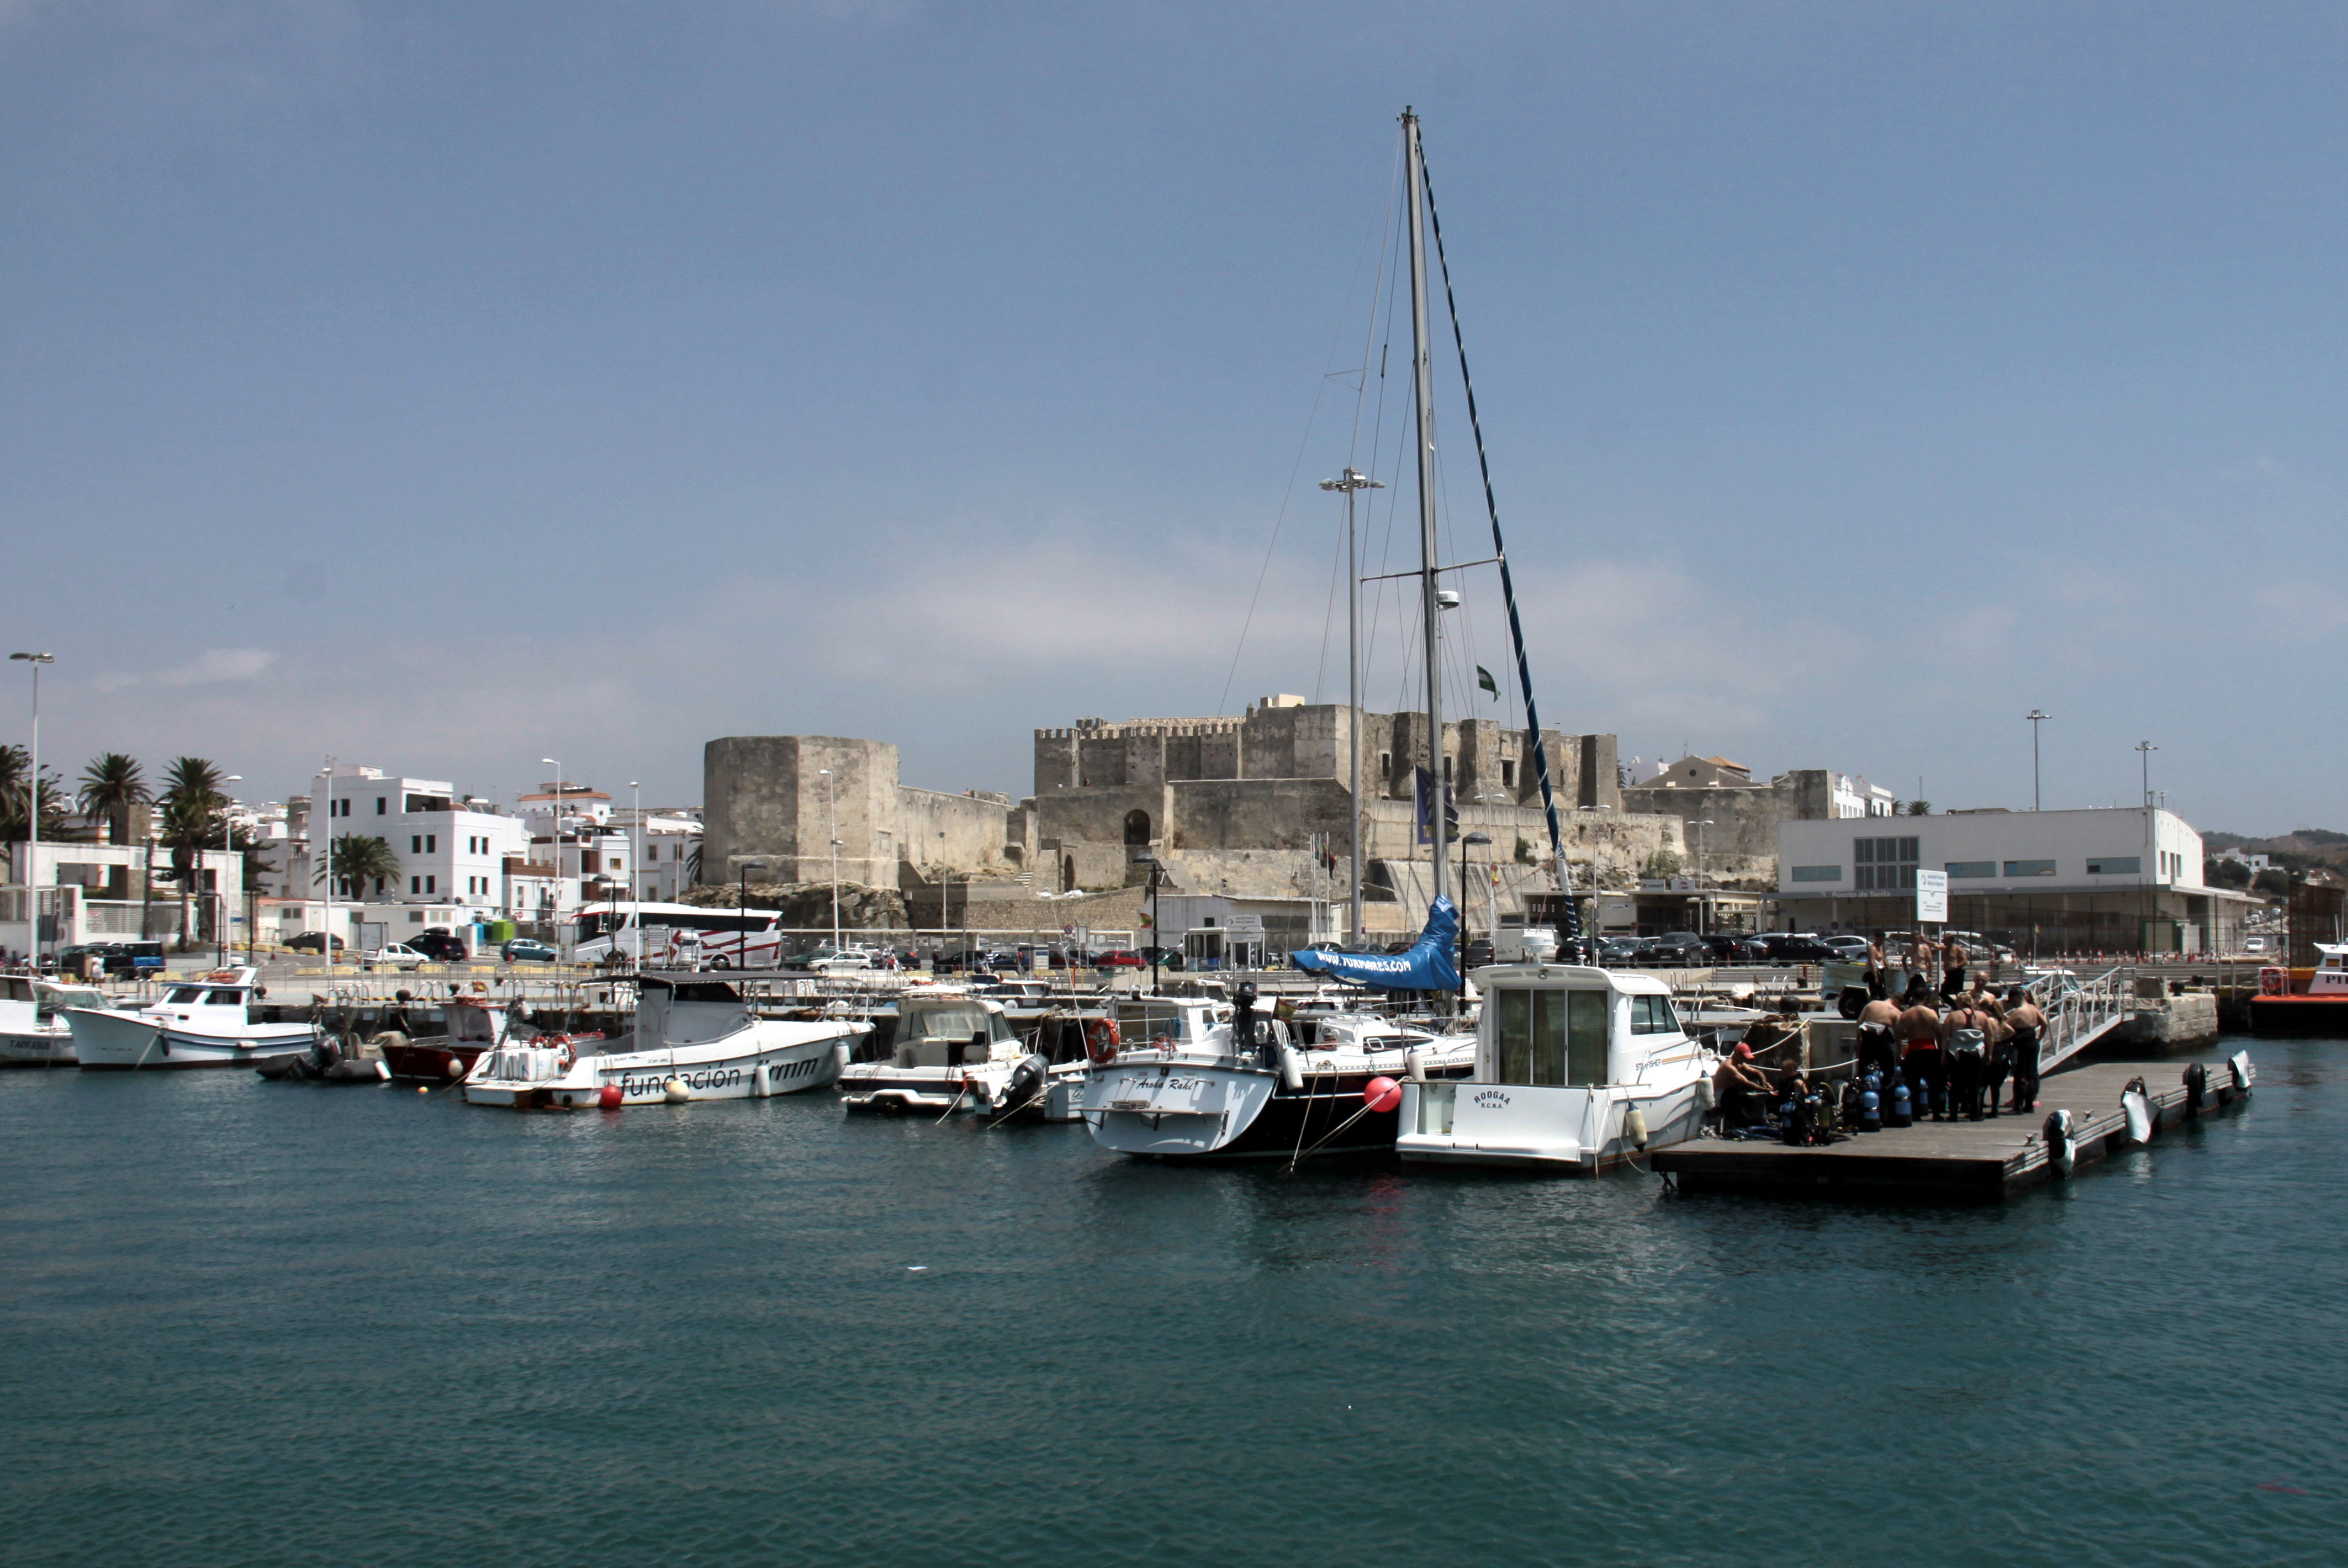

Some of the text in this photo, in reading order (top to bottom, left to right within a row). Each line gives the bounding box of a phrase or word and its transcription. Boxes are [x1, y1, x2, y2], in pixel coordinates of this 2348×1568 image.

[9, 1040, 51, 1050] TARIFASUB
[1136, 1078, 1193, 1090] Aroha Rahi
[1474, 1090, 1510, 1105] ROOGAA
